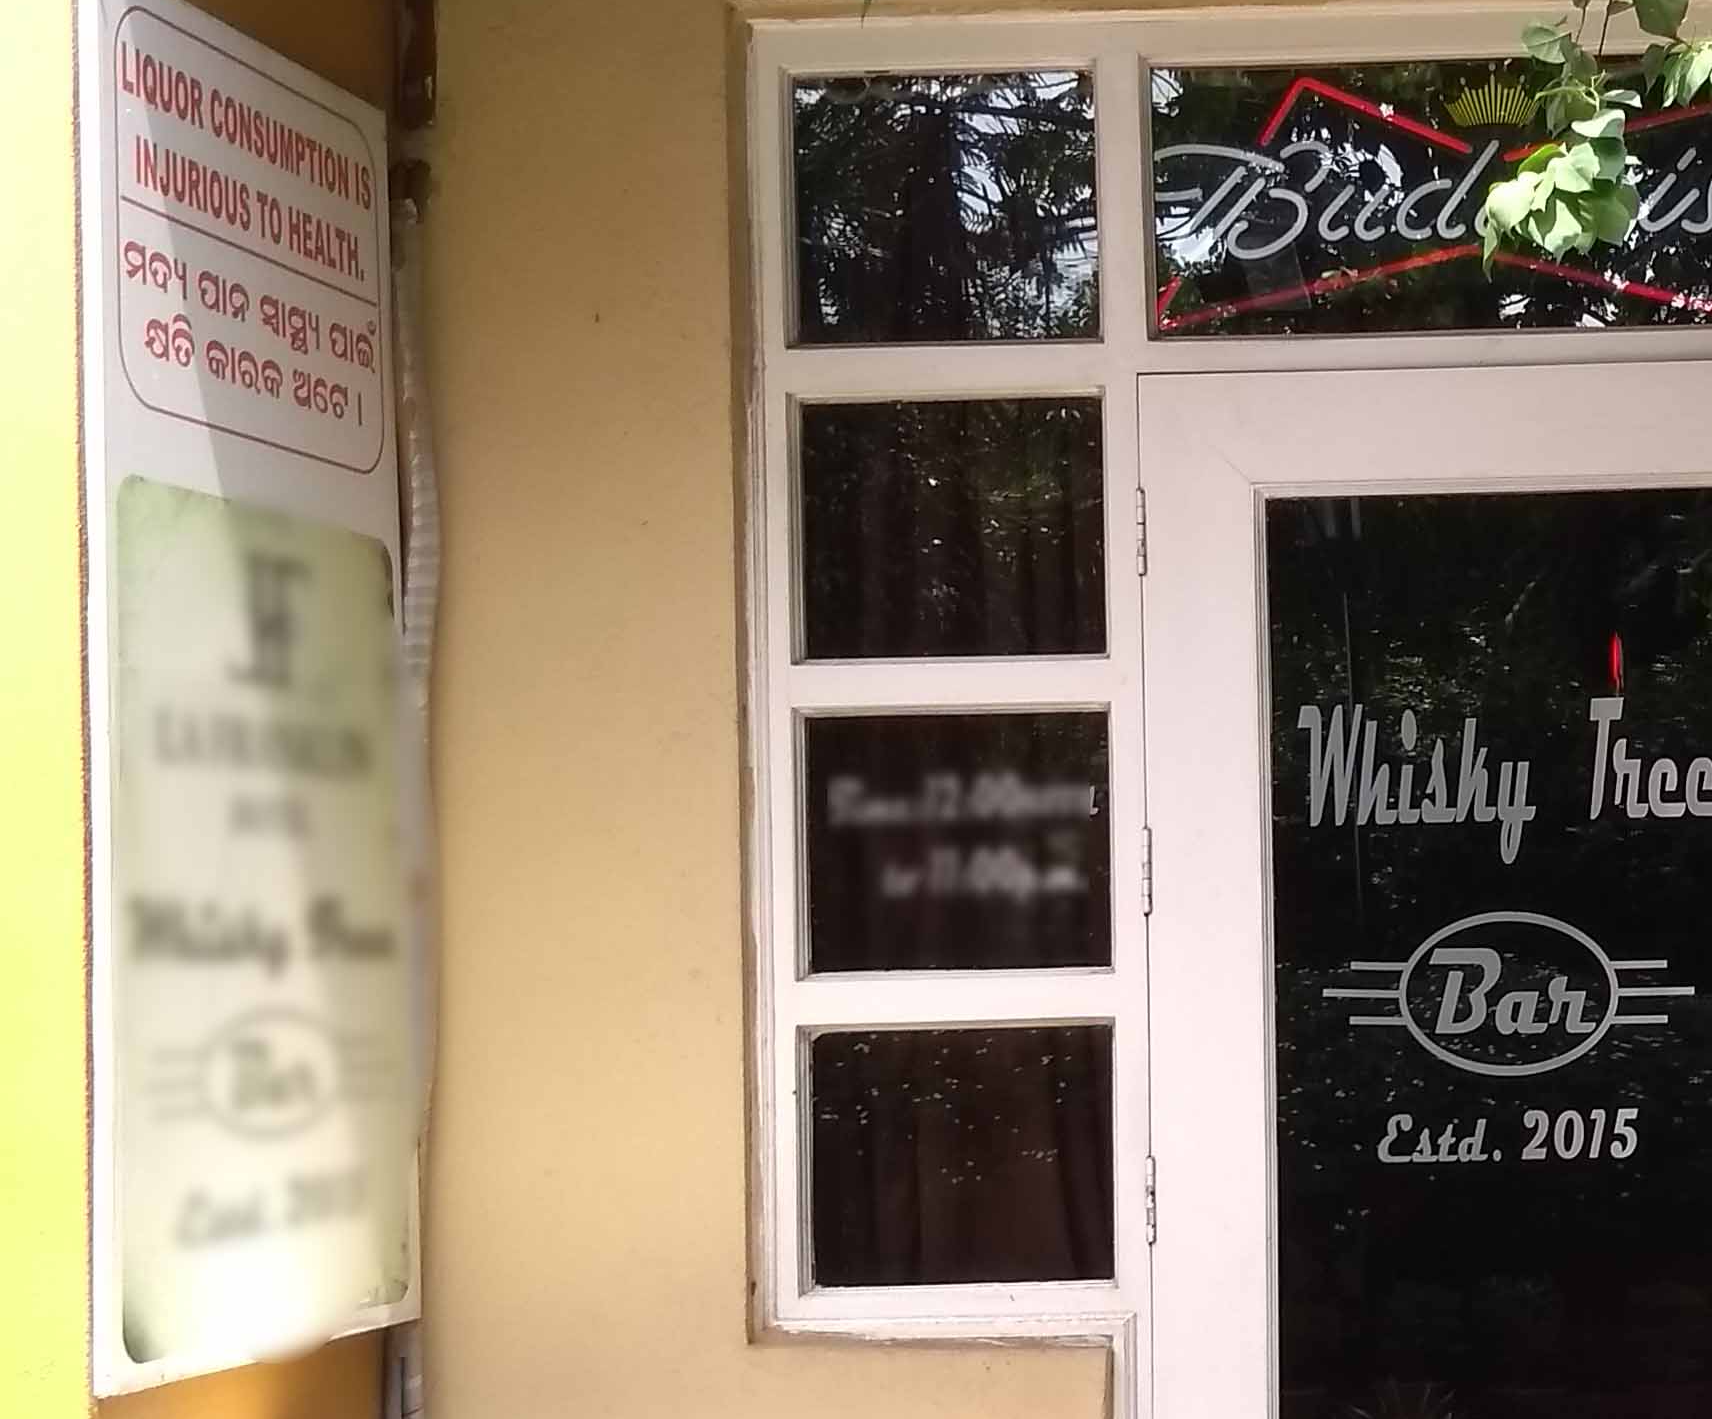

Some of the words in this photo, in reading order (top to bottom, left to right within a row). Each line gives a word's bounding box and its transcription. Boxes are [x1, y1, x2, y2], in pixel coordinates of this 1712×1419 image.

[121, 42, 204, 129] LIQUOR
[210, 87, 349, 198] CONSUMPTION
[355, 162, 372, 210] IS
[136, 135, 251, 232] INJURIOUS
[257, 191, 282, 245] TO
[289, 206, 365, 281] HEALTH.
[198, 271, 249, 322] ପାନ
[1298, 703, 1536, 865] Whisky
[1429, 948, 1597, 1035] Bar
[1376, 1113, 1502, 1164] Estd.
[1521, 1107, 1639, 1161] 2015
